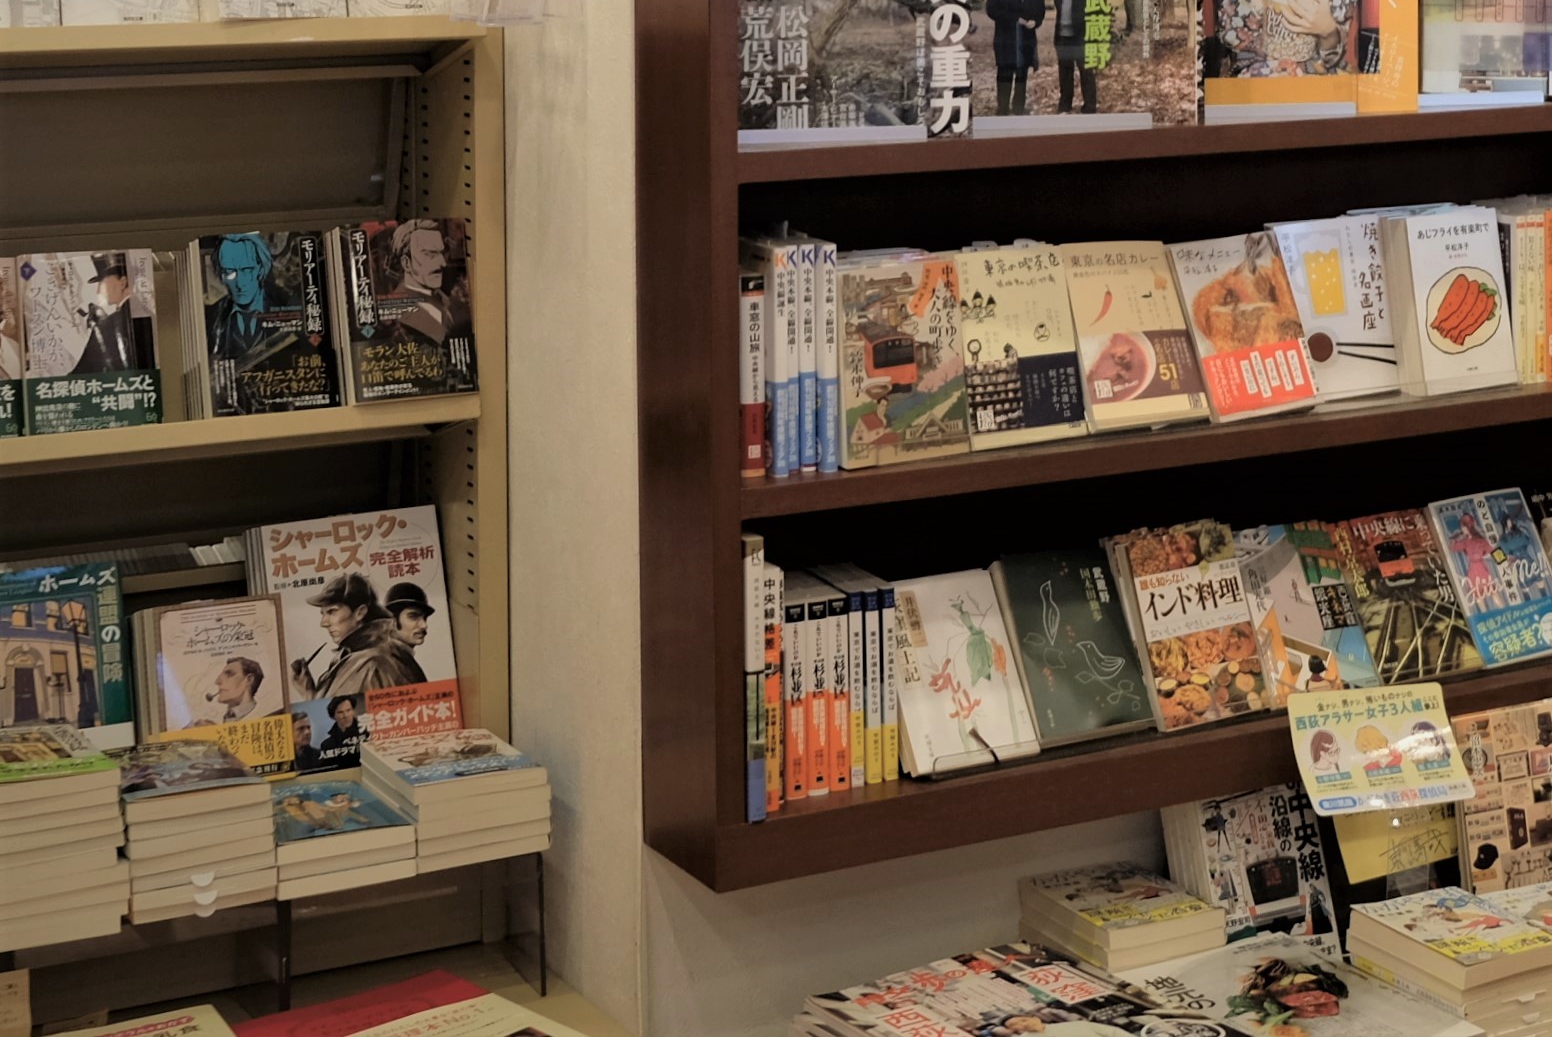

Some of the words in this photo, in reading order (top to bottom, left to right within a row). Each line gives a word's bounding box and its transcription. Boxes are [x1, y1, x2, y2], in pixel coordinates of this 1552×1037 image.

[738, 7, 775, 106] 荒俣宏
[1416, 222, 1490, 241] あじフライを有楽町で
[351, 230, 376, 325] モリアーティ秘録
[1070, 251, 1160, 268] 東京の名店カレー
[1361, 221, 1386, 320] 焼き餃子と
[300, 238, 324, 334] モリアーティ秘録
[776, 271, 787, 318] 中央線誕生
[1358, 270, 1378, 332] 名画座
[29, 285, 48, 372] ワトスン博士
[748, 300, 761, 354] 車窓の山旅
[35, 375, 155, 400] 名探偵ホームズと
[240, 366, 327, 383] アフガニスタンに
[1158, 364, 1179, 382] 51
[268, 512, 409, 552] シャーロック・
[269, 543, 365, 580] ホームズ
[369, 544, 436, 565] 完全解析
[386, 562, 422, 579] 読本
[38, 566, 116, 596] ホームズ
[1144, 574, 1245, 623] インド料理
[763, 577, 778, 653] 中央線格差
[240, 724, 251, 747] まだ
[357, 700, 457, 734] 完全ガイド本!
[1295, 699, 1425, 732] 西荻アラサー女子3人組
[263, 720, 276, 761] 名探偵の
[274, 719, 286, 760] 偉大なる
[1268, 794, 1293, 852] 沿線の
[1287, 789, 1326, 883] 中央線
